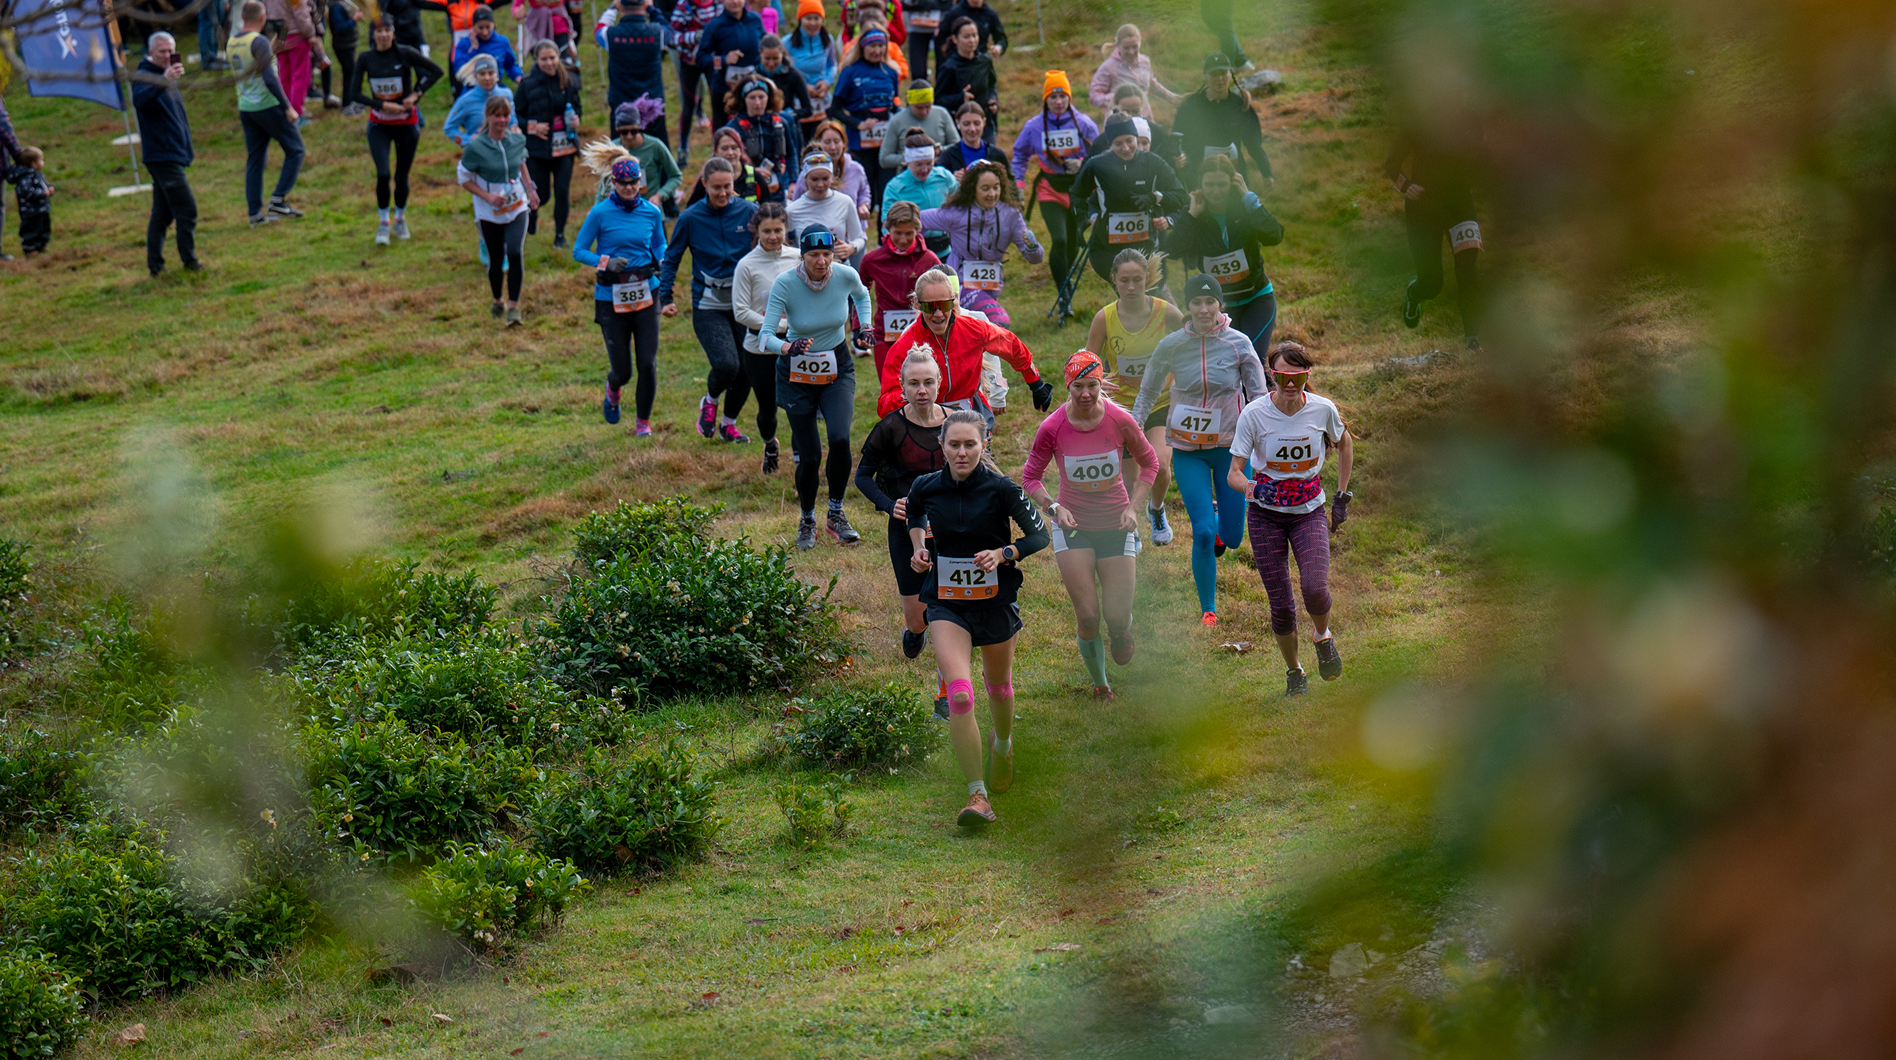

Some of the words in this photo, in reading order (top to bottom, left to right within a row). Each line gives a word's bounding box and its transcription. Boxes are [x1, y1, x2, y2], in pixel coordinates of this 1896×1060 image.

[1047, 136, 1072, 148] 438
[1115, 220, 1144, 232] 406
[1210, 259, 1241, 275] 439
[970, 269, 996, 280] 428
[620, 289, 645, 302] 383
[797, 360, 830, 373] 402
[1179, 416, 1211, 432] 417
[1275, 444, 1311, 460] 401
[1072, 462, 1115, 480] 400
[949, 569, 986, 585] 412
